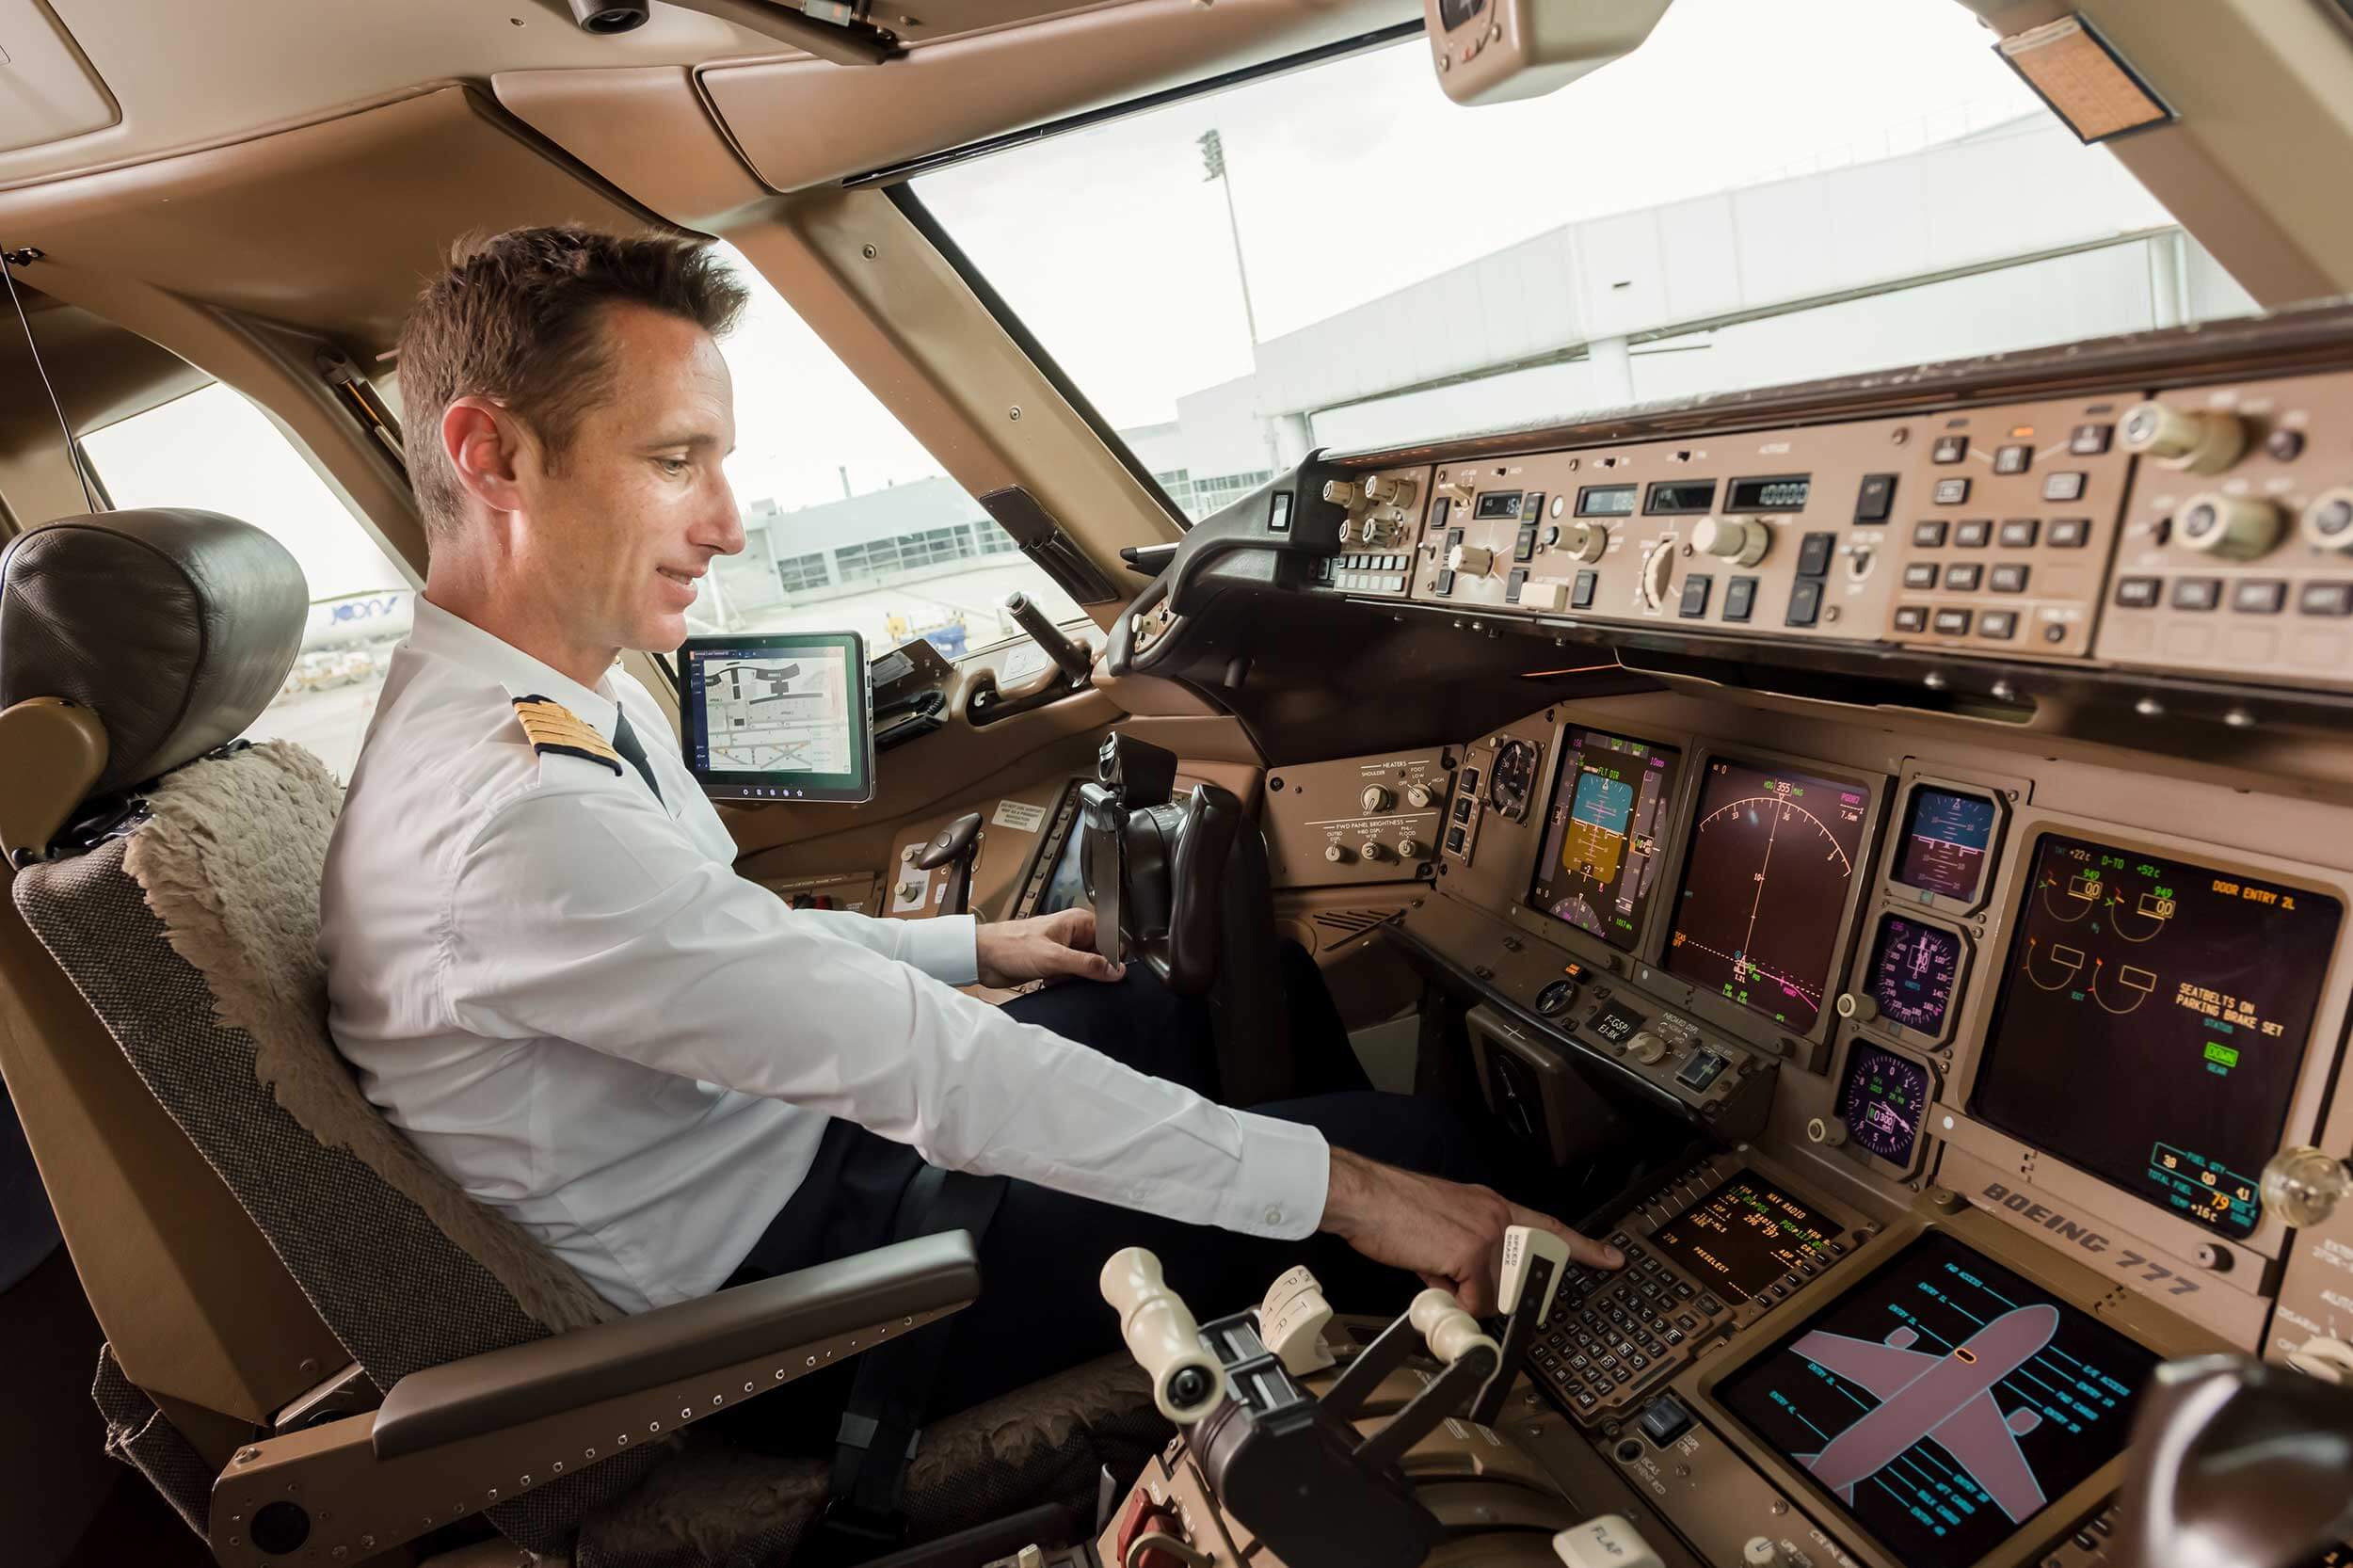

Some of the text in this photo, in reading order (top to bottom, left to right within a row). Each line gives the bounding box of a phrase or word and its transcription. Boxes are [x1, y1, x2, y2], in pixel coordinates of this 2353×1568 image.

[1776, 781, 1791, 793] 355
[2212, 879, 2296, 910] DOOR ENTRY 2L
[2179, 982, 2255, 1016] SEATBELTS ON
[2175, 993, 2284, 1037] PARKING BRAKE SET
[1889, 1066, 1896, 1076] 0
[1910, 1100, 1916, 1110] 2
[1873, 1133, 1879, 1142] 5
[1782, 1202, 1806, 1220] RADIO
[1982, 1182, 2201, 1295] BOEING 777
[1693, 1245, 1730, 1274] PRESELECT
